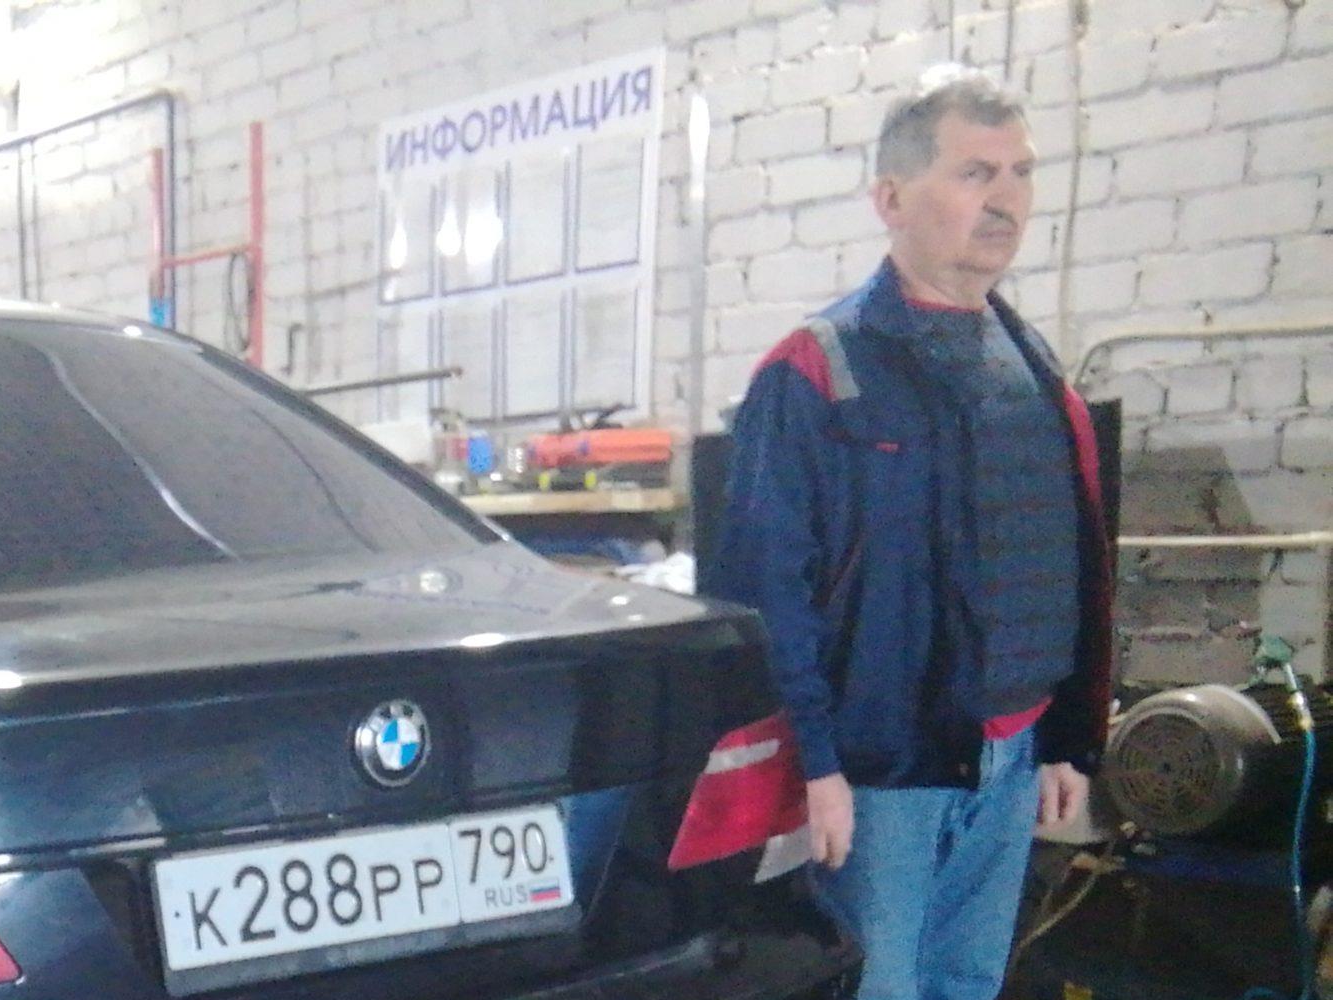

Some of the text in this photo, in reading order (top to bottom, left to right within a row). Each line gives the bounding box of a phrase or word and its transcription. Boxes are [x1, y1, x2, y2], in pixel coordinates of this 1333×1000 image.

[385, 66, 653, 172] ИНФОРМАЦИЯ
[458, 821, 548, 885] 790
[485, 887, 528, 909] RUS
